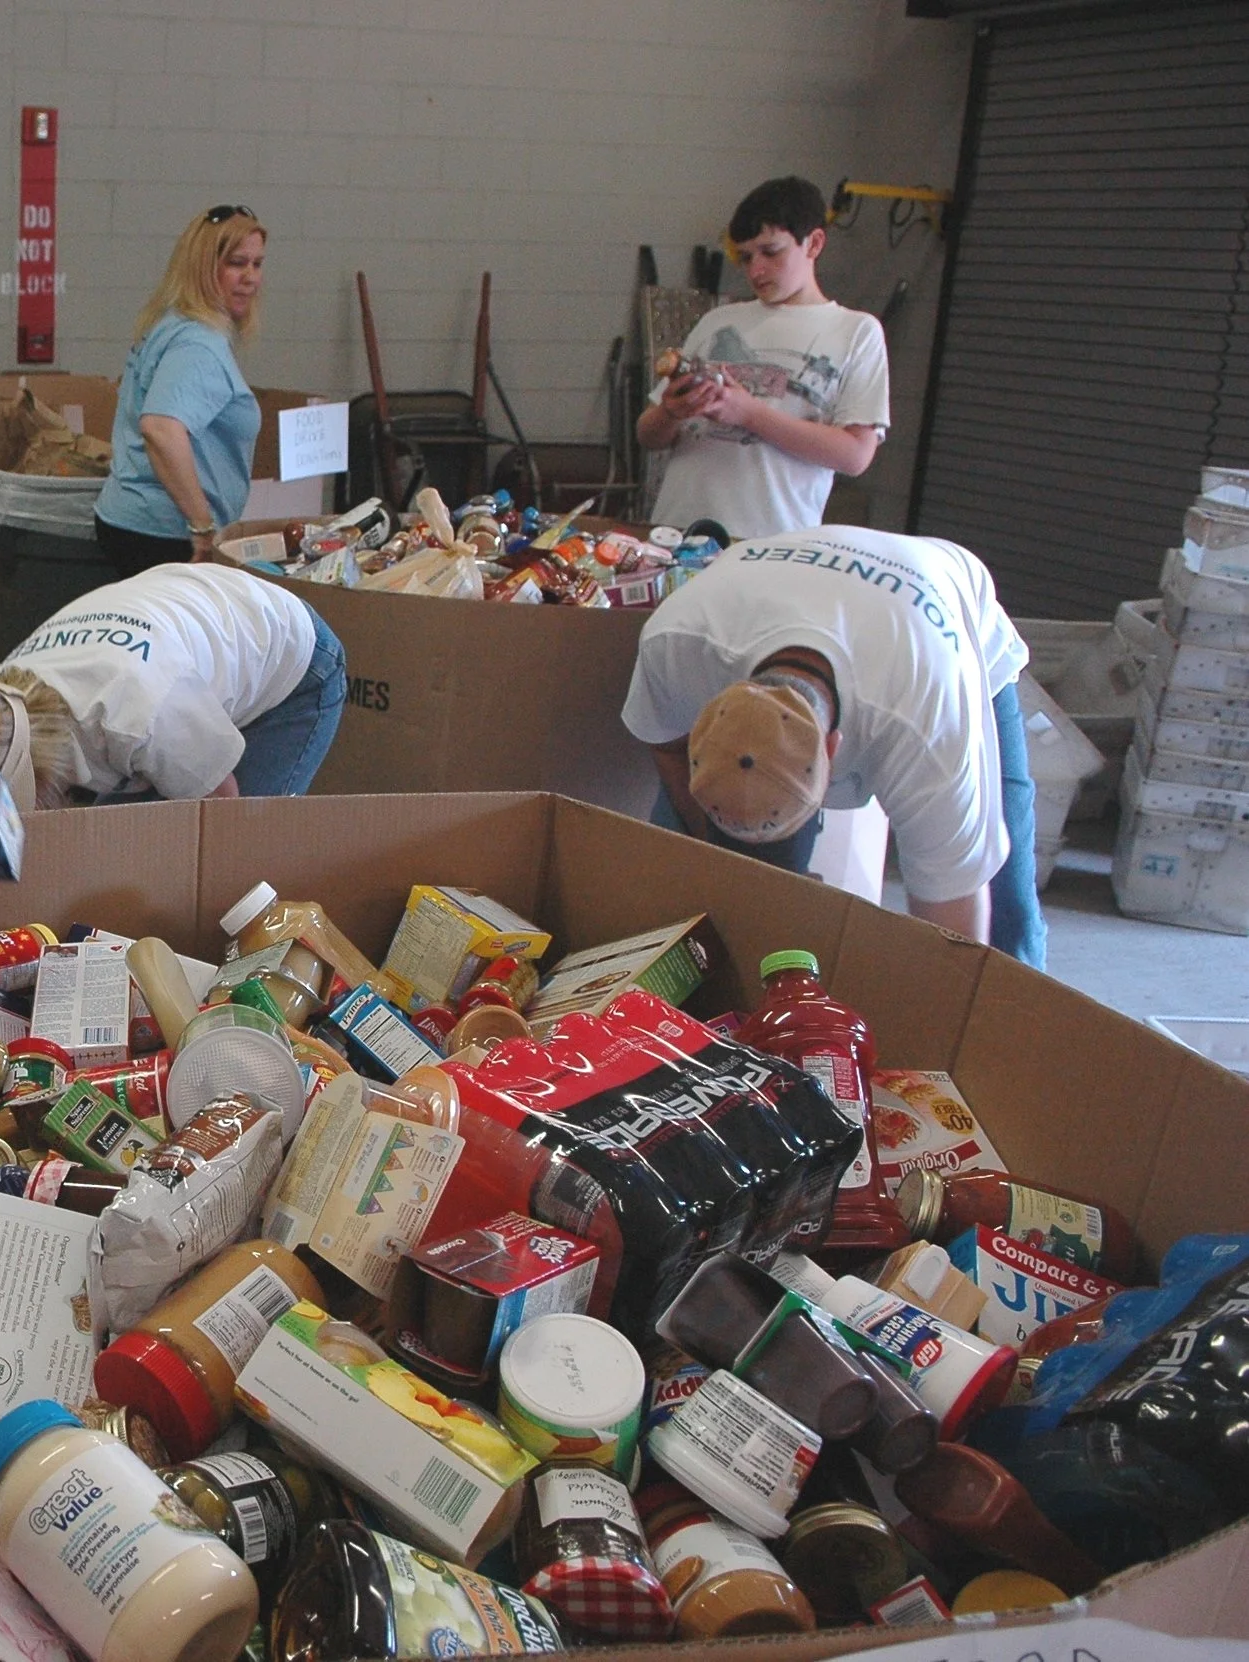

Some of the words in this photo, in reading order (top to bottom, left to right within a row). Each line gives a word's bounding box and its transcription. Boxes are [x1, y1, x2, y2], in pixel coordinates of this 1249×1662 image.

[24, 204, 52, 229] DO
[16, 238, 54, 262] NOT
[0, 273, 68, 296] BLOCK
[739, 547, 960, 654] VOLUNTEER
[347, 677, 391, 712] MES
[342, 995, 367, 1026] Prince
[418, 1016, 446, 1047] LINDS
[580, 1062, 772, 1150] POWERADE
[934, 1103, 963, 1115] FIBER
[96, 1122, 120, 1146] Lemon
[941, 1115, 973, 1131] 40%
[58, 1235, 70, 1259] Organic
[547, 1236, 575, 1263] Snack
[991, 1236, 1080, 1288] Compare
[1082, 1279, 1101, 1296] &
[17, 1350, 25, 1377] Organic
[274, 1340, 296, 1357] Perfect
[293, 1353, 303, 1363] for
[308, 1364, 326, 1379] home
[338, 1387, 349, 1397] the
[913, 1340, 940, 1366] IGA
[732, 1464, 771, 1499] Nutrition
[751, 1470, 776, 1491] Facts
[28, 1468, 94, 1536] Great
[53, 1486, 104, 1532] Value
[67, 1521, 109, 1571] Mayonnaise
[73, 1555, 92, 1577] Type
[88, 1524, 121, 1558] Dressing
[92, 1573, 114, 1597] Sauce
[110, 1562, 123, 1574] de
[120, 1545, 140, 1568] type
[100, 1556, 141, 1606] mayonnaise
[481, 1602, 506, 1633] White
[498, 1585, 538, 1653] ORCHA
